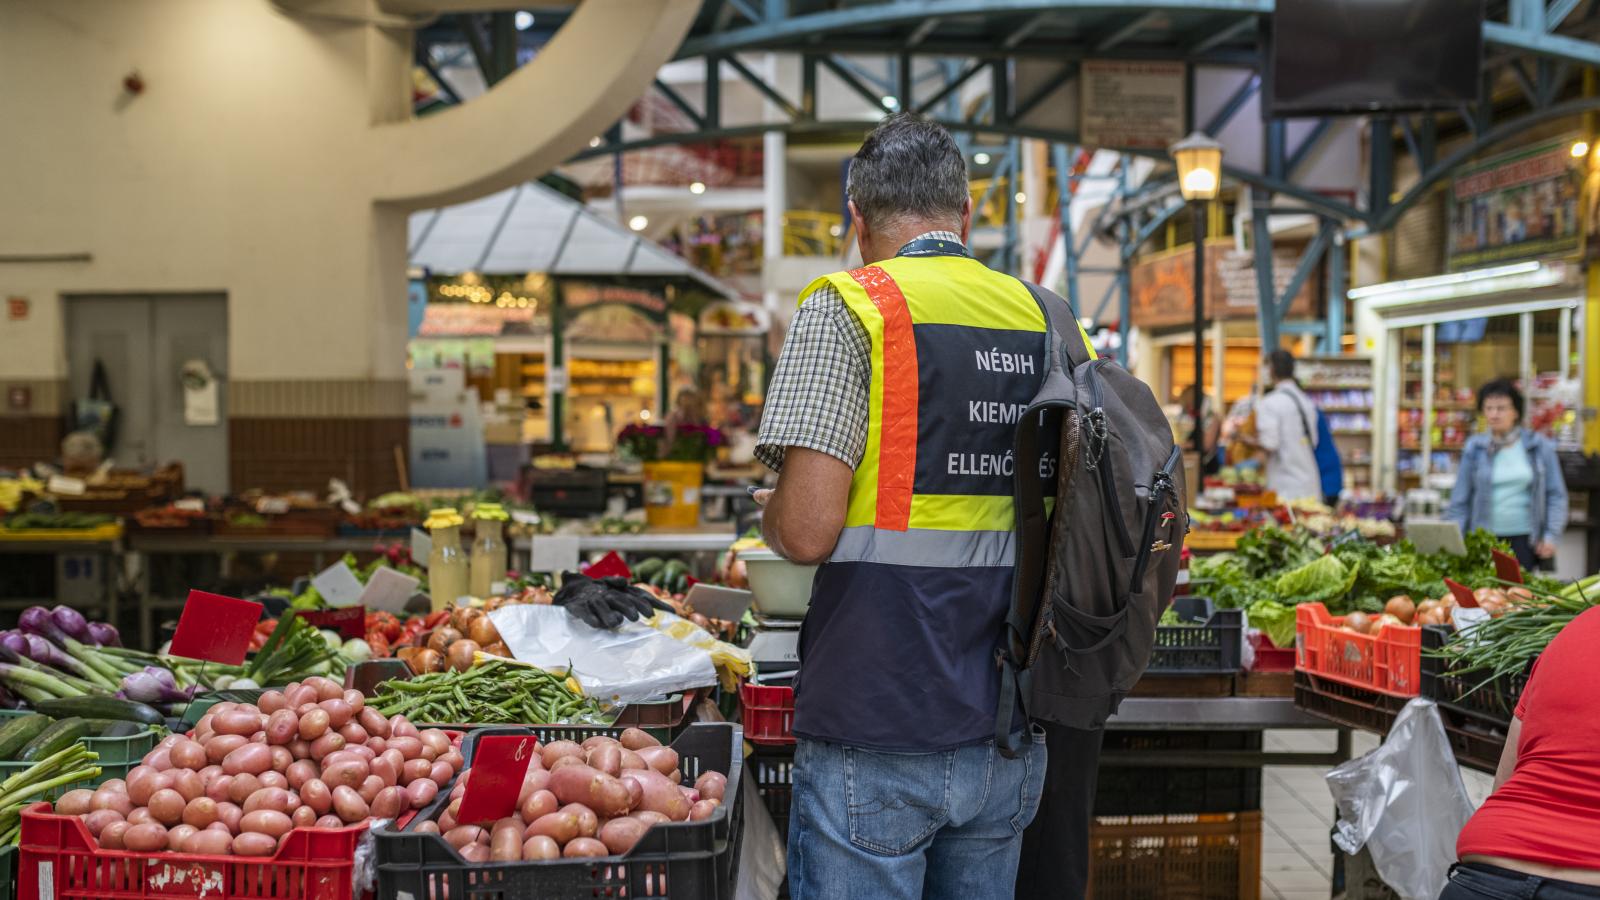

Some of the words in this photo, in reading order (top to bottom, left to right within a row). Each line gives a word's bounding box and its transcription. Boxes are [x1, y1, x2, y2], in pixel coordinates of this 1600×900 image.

[975, 347, 1035, 375] NÉBIH
[969, 400, 1047, 427] KIEMET
[947, 449, 1056, 478] ELLENŐÉS
